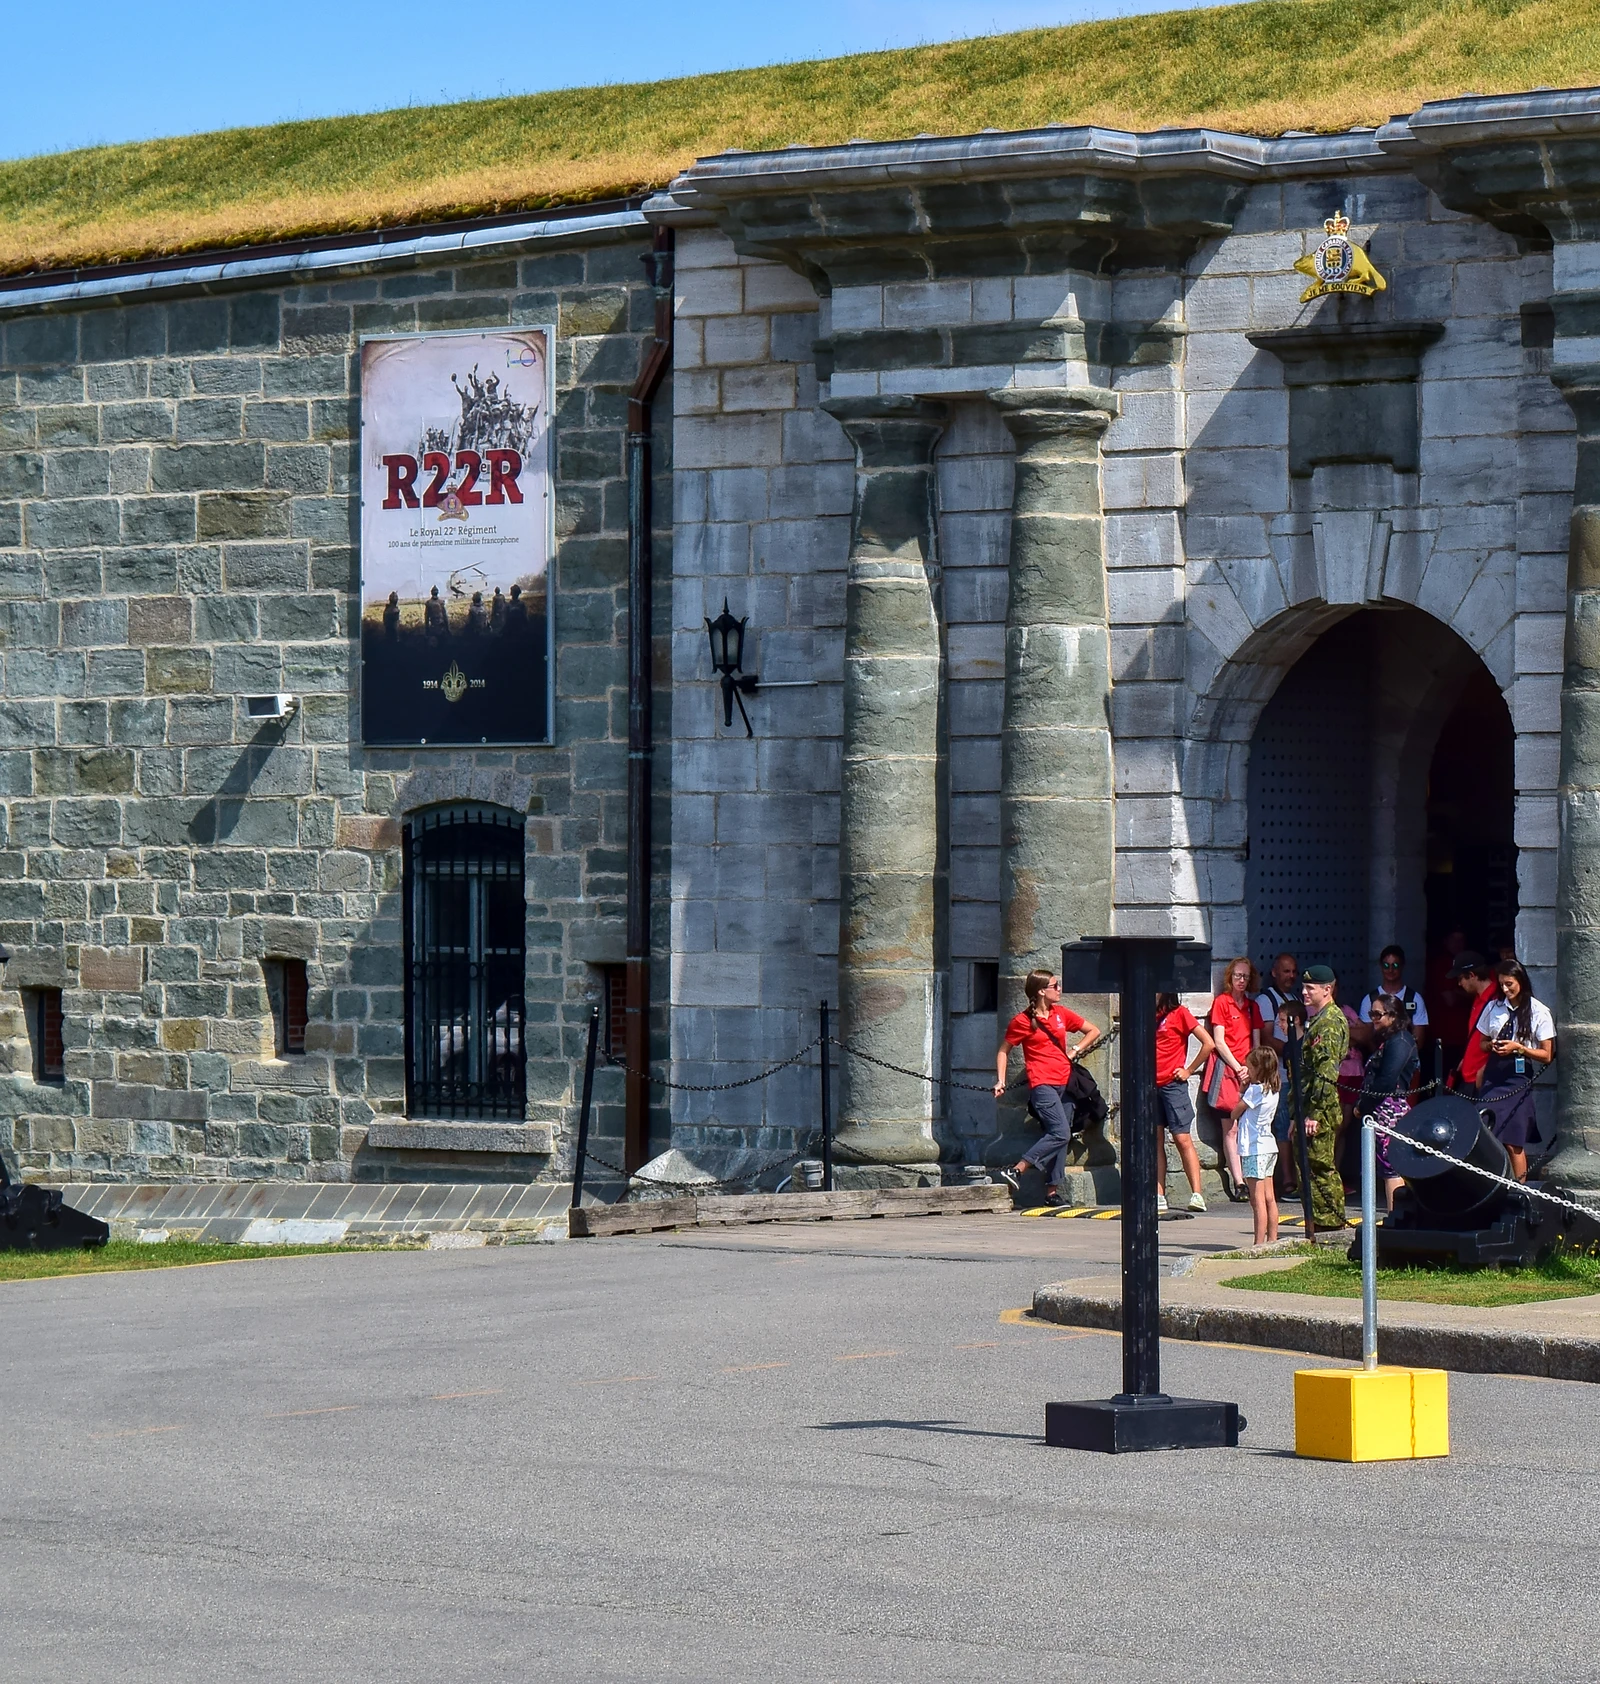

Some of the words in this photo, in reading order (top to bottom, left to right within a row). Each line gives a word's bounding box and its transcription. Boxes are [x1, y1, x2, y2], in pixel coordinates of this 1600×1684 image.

[1308, 289, 1317, 298] JE
[1318, 285, 1329, 293] ME
[1330, 284, 1367, 293] SOUVIENS
[409, 528, 419, 537] Le
[420, 526, 442, 539] Royal
[458, 524, 497, 538] Régiment
[388, 540, 399, 548] 100
[420, 539, 453, 549] patrimoine
[454, 537, 480, 546] militaire
[481, 535, 519, 546] francophone
[423, 680, 438, 689] 1914
[470, 679, 485, 688] 2014
